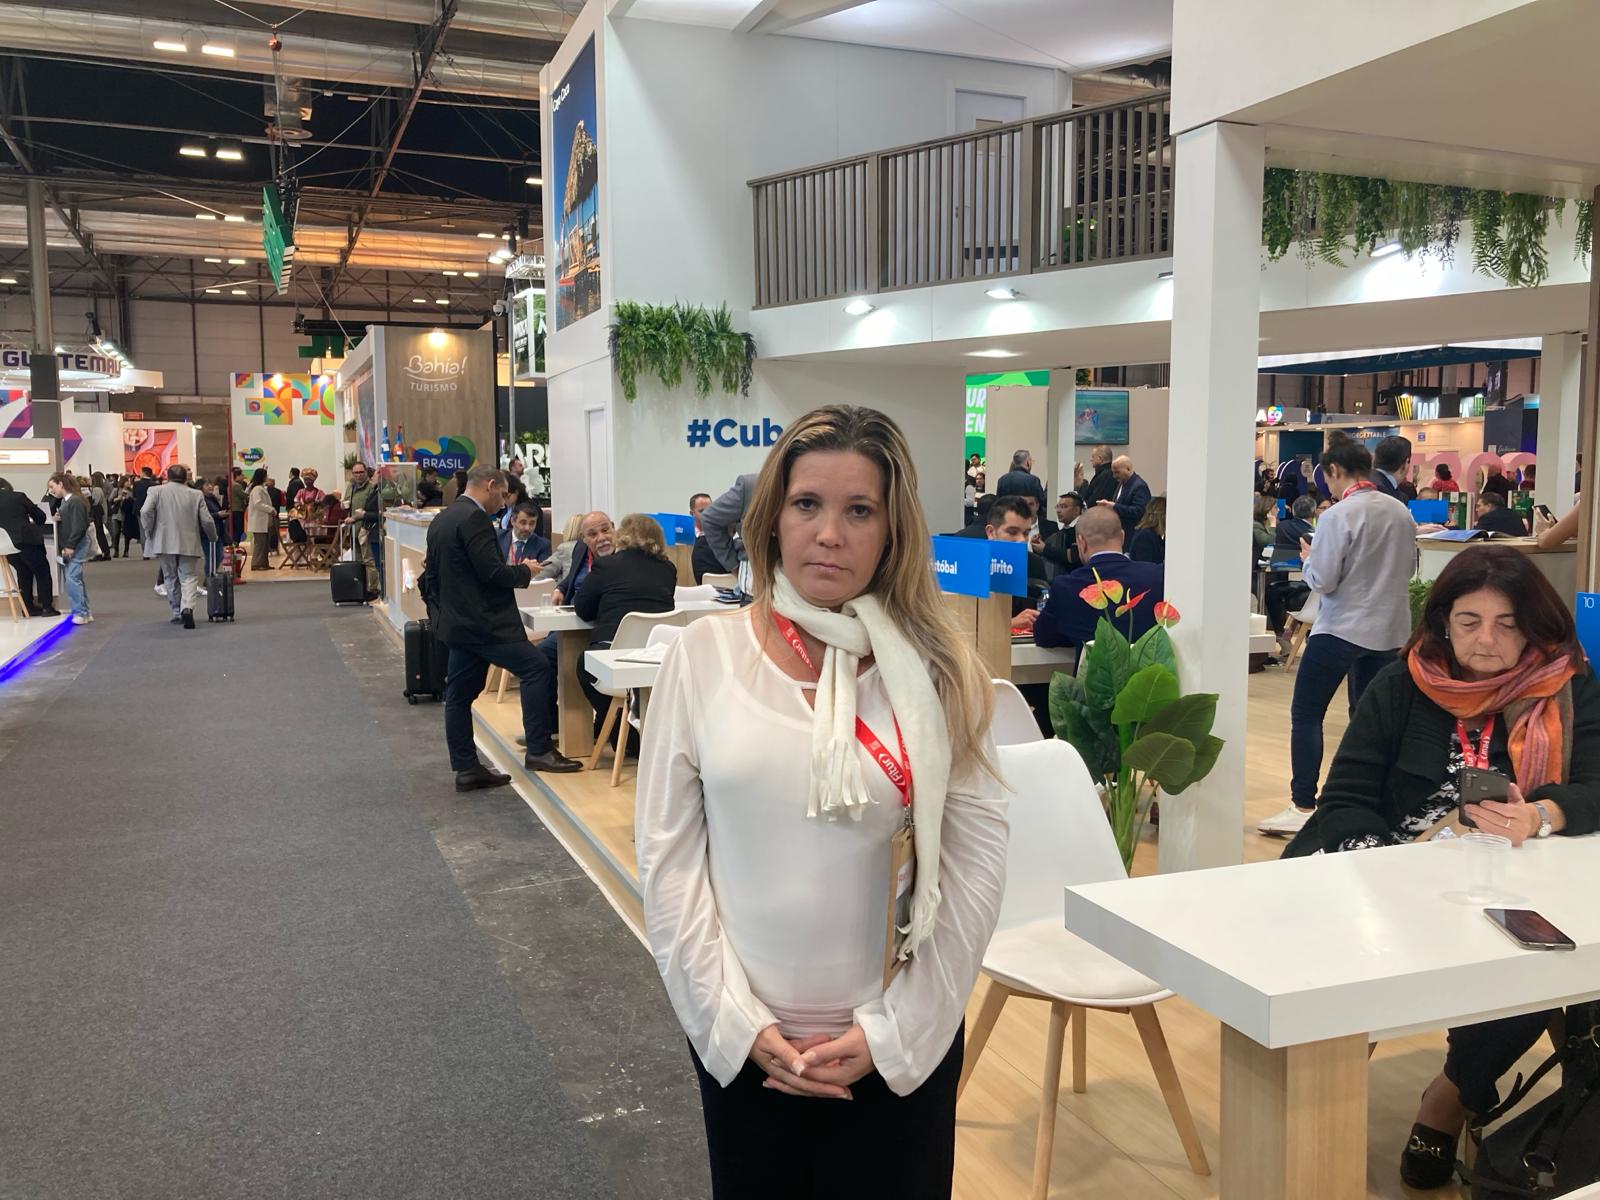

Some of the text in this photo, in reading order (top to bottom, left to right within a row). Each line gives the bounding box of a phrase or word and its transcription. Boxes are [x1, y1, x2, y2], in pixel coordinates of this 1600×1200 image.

[403, 354, 468, 376] Bahia!
[409, 382, 458, 393] TURISMO
[422, 457, 465, 470] BRASIL
[1583, 596, 1595, 609] 10
